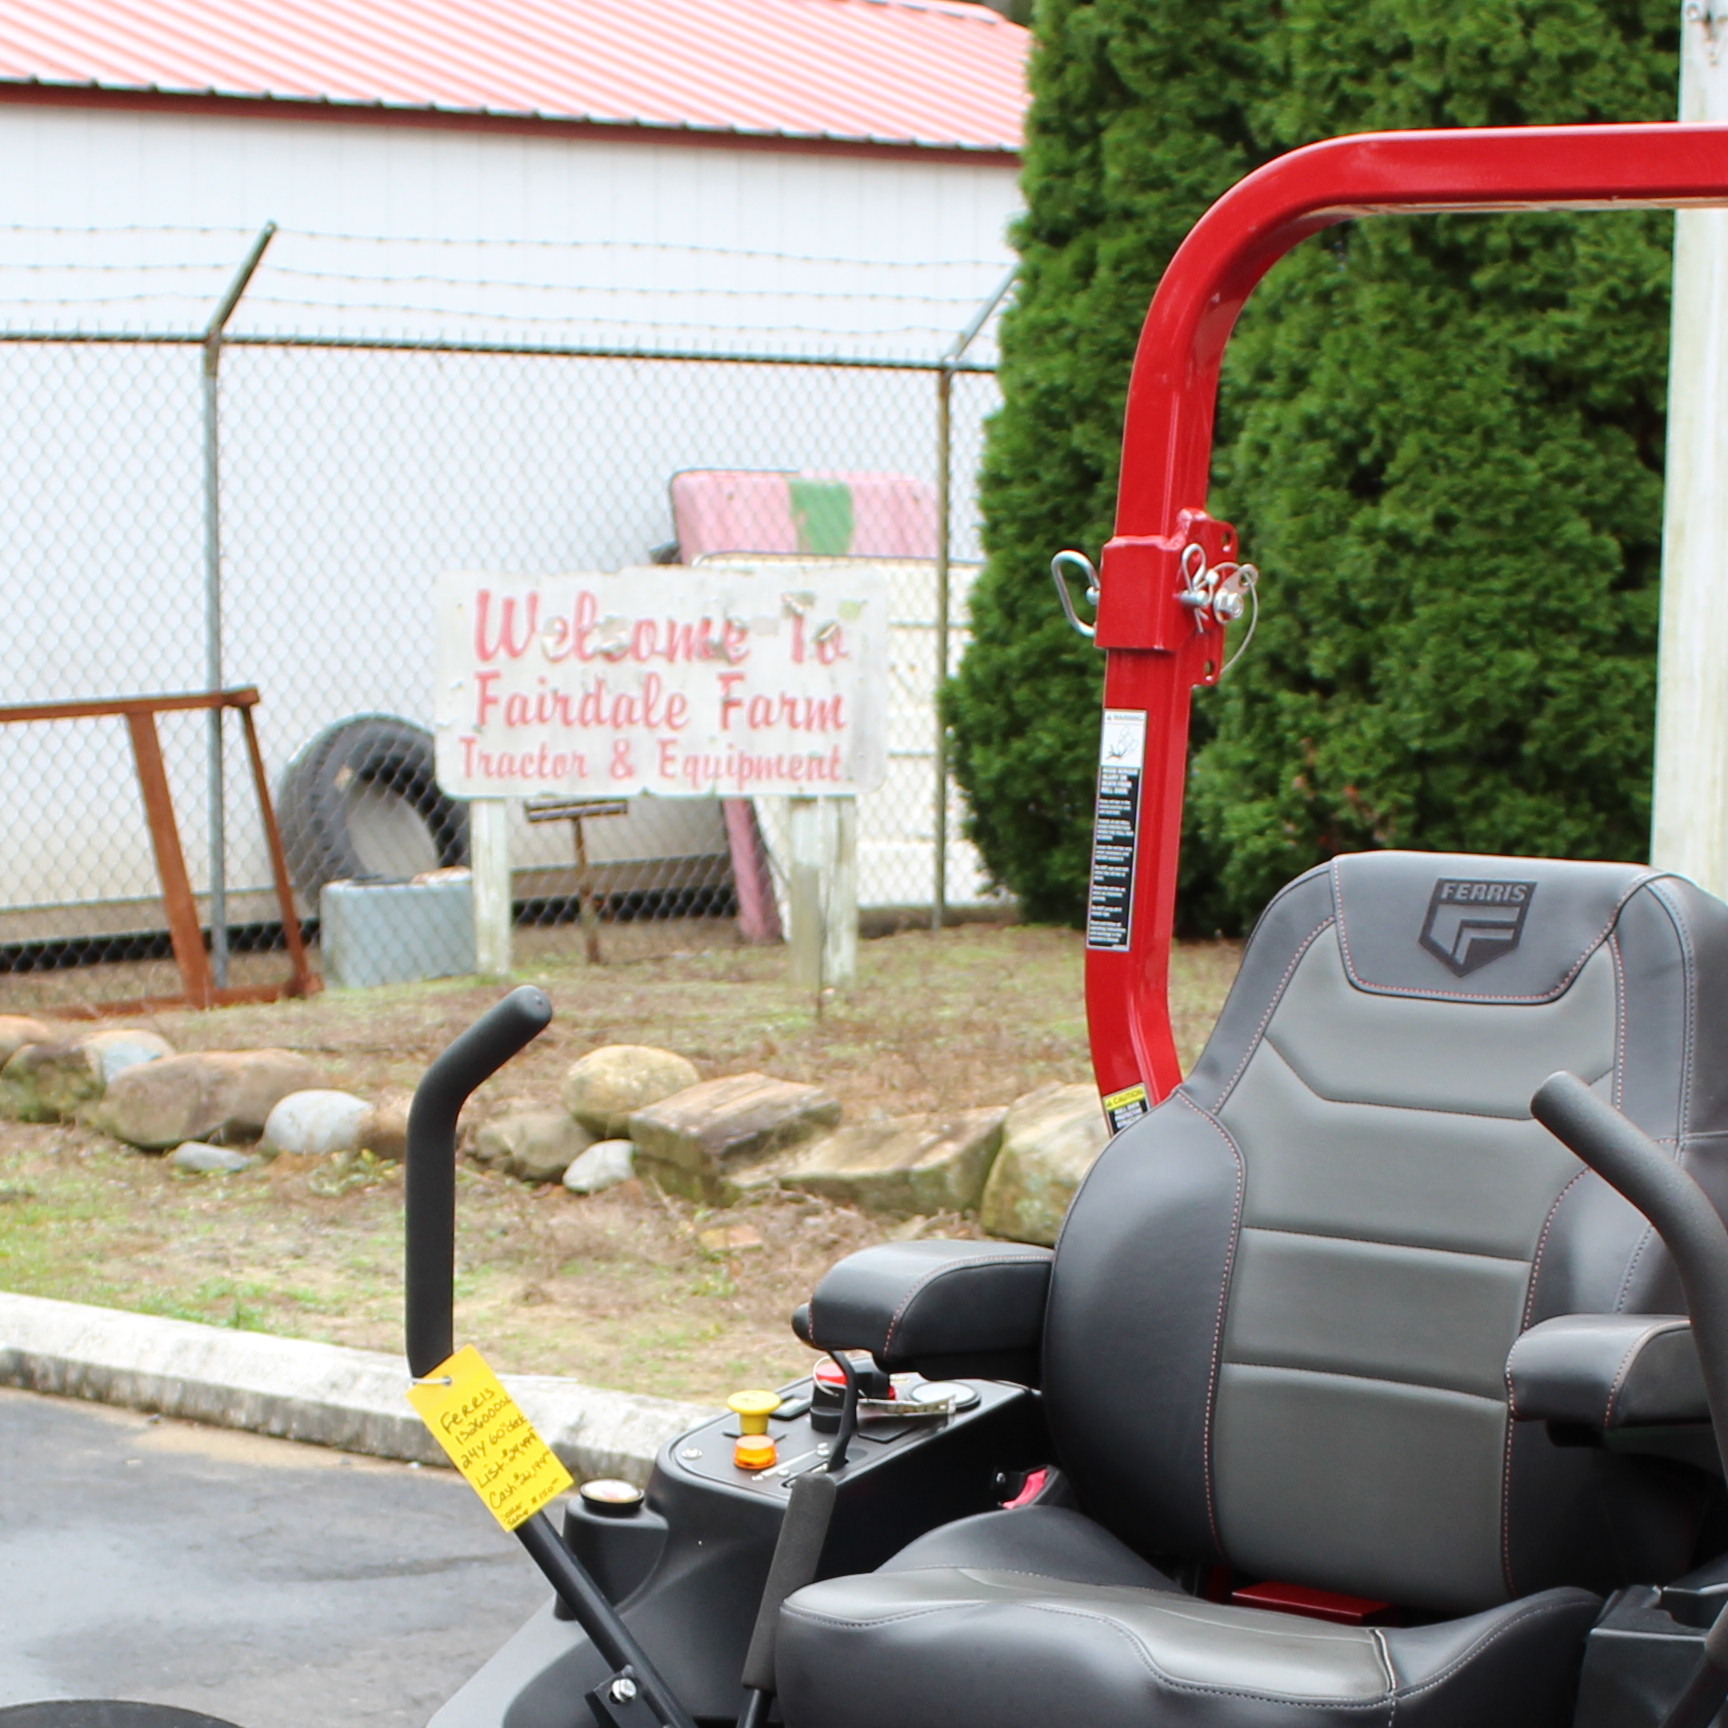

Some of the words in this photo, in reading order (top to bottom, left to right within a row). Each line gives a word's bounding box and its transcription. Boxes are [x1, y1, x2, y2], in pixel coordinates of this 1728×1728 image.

[473, 589, 749, 664] Welcome
[473, 671, 690, 729] Fairdale
[718, 672, 848, 730] Farm
[459, 736, 589, 779] Tractor
[609, 740, 634, 779] &
[658, 739, 842, 791] Equipment
[1441, 883, 1527, 902] FERRIS
